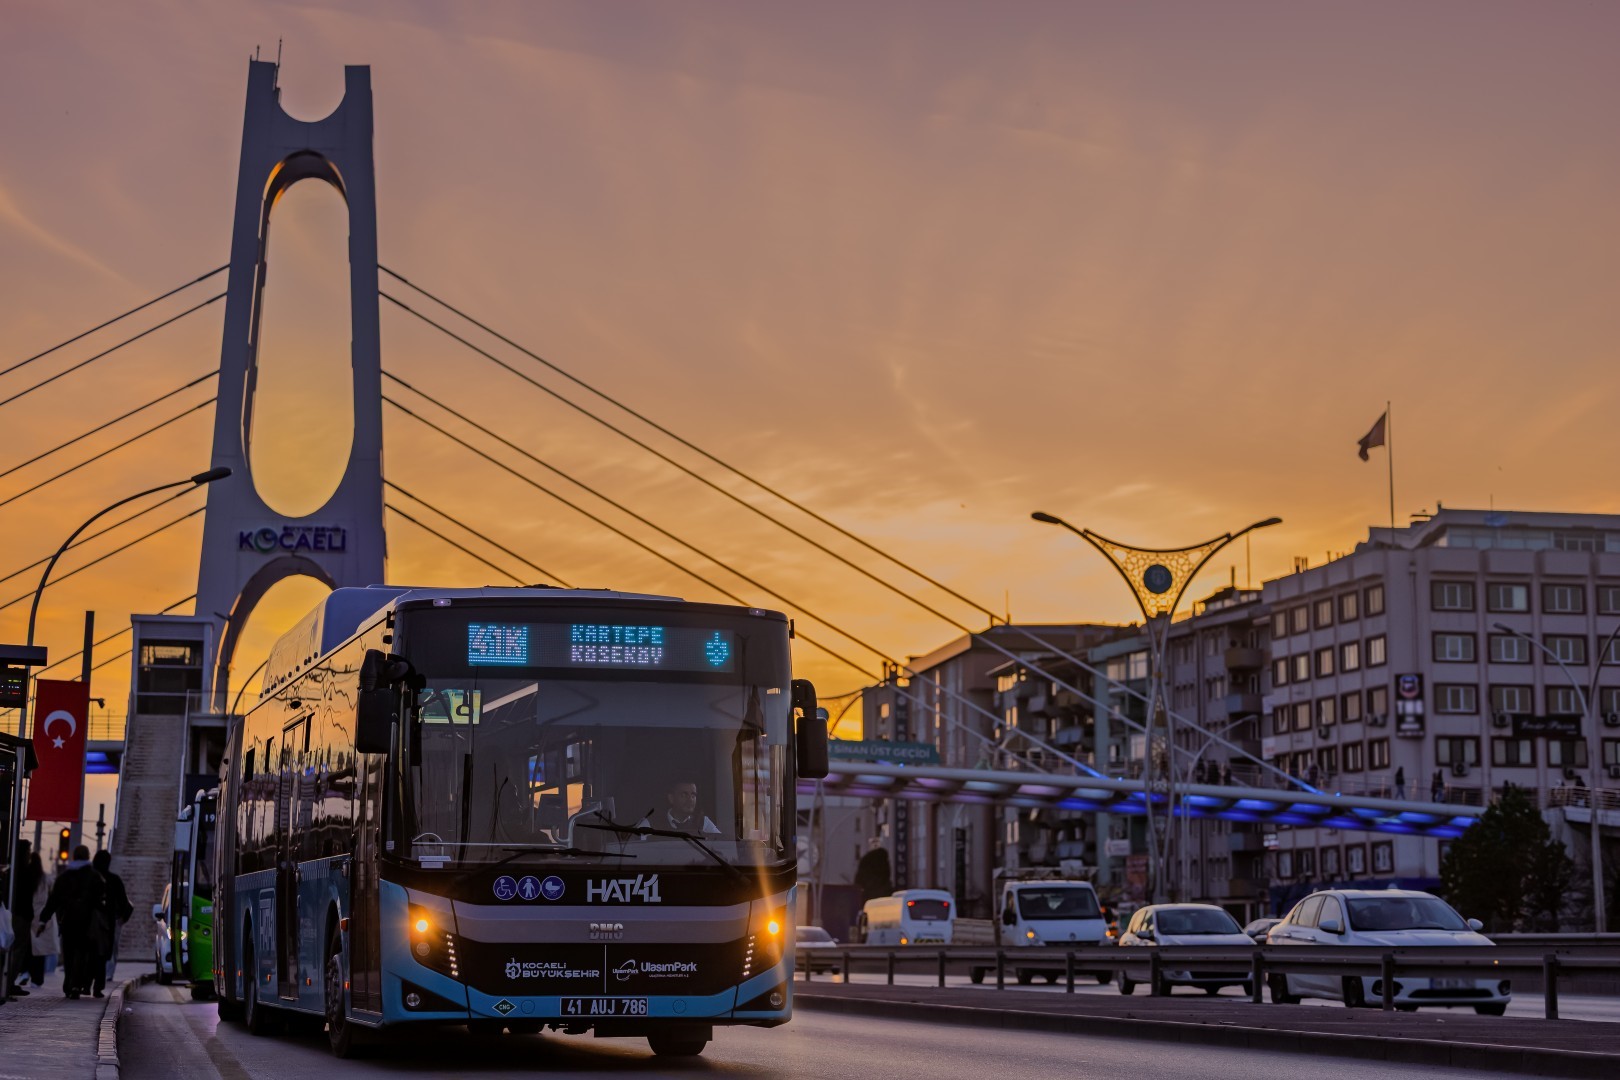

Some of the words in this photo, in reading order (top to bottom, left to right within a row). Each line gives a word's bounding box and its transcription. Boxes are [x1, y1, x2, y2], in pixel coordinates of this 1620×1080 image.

[572, 625, 663, 644] KARTEPE
[471, 628, 522, 657] 41K
[870, 744, 891, 756] ÜST
[892, 746, 930, 759] GEÇİDİ
[522, 970, 600, 979] BÜYÜKŞEHİR
[567, 999, 582, 1014] 41
[590, 999, 616, 1014] AUJ
[622, 999, 647, 1014] 786
